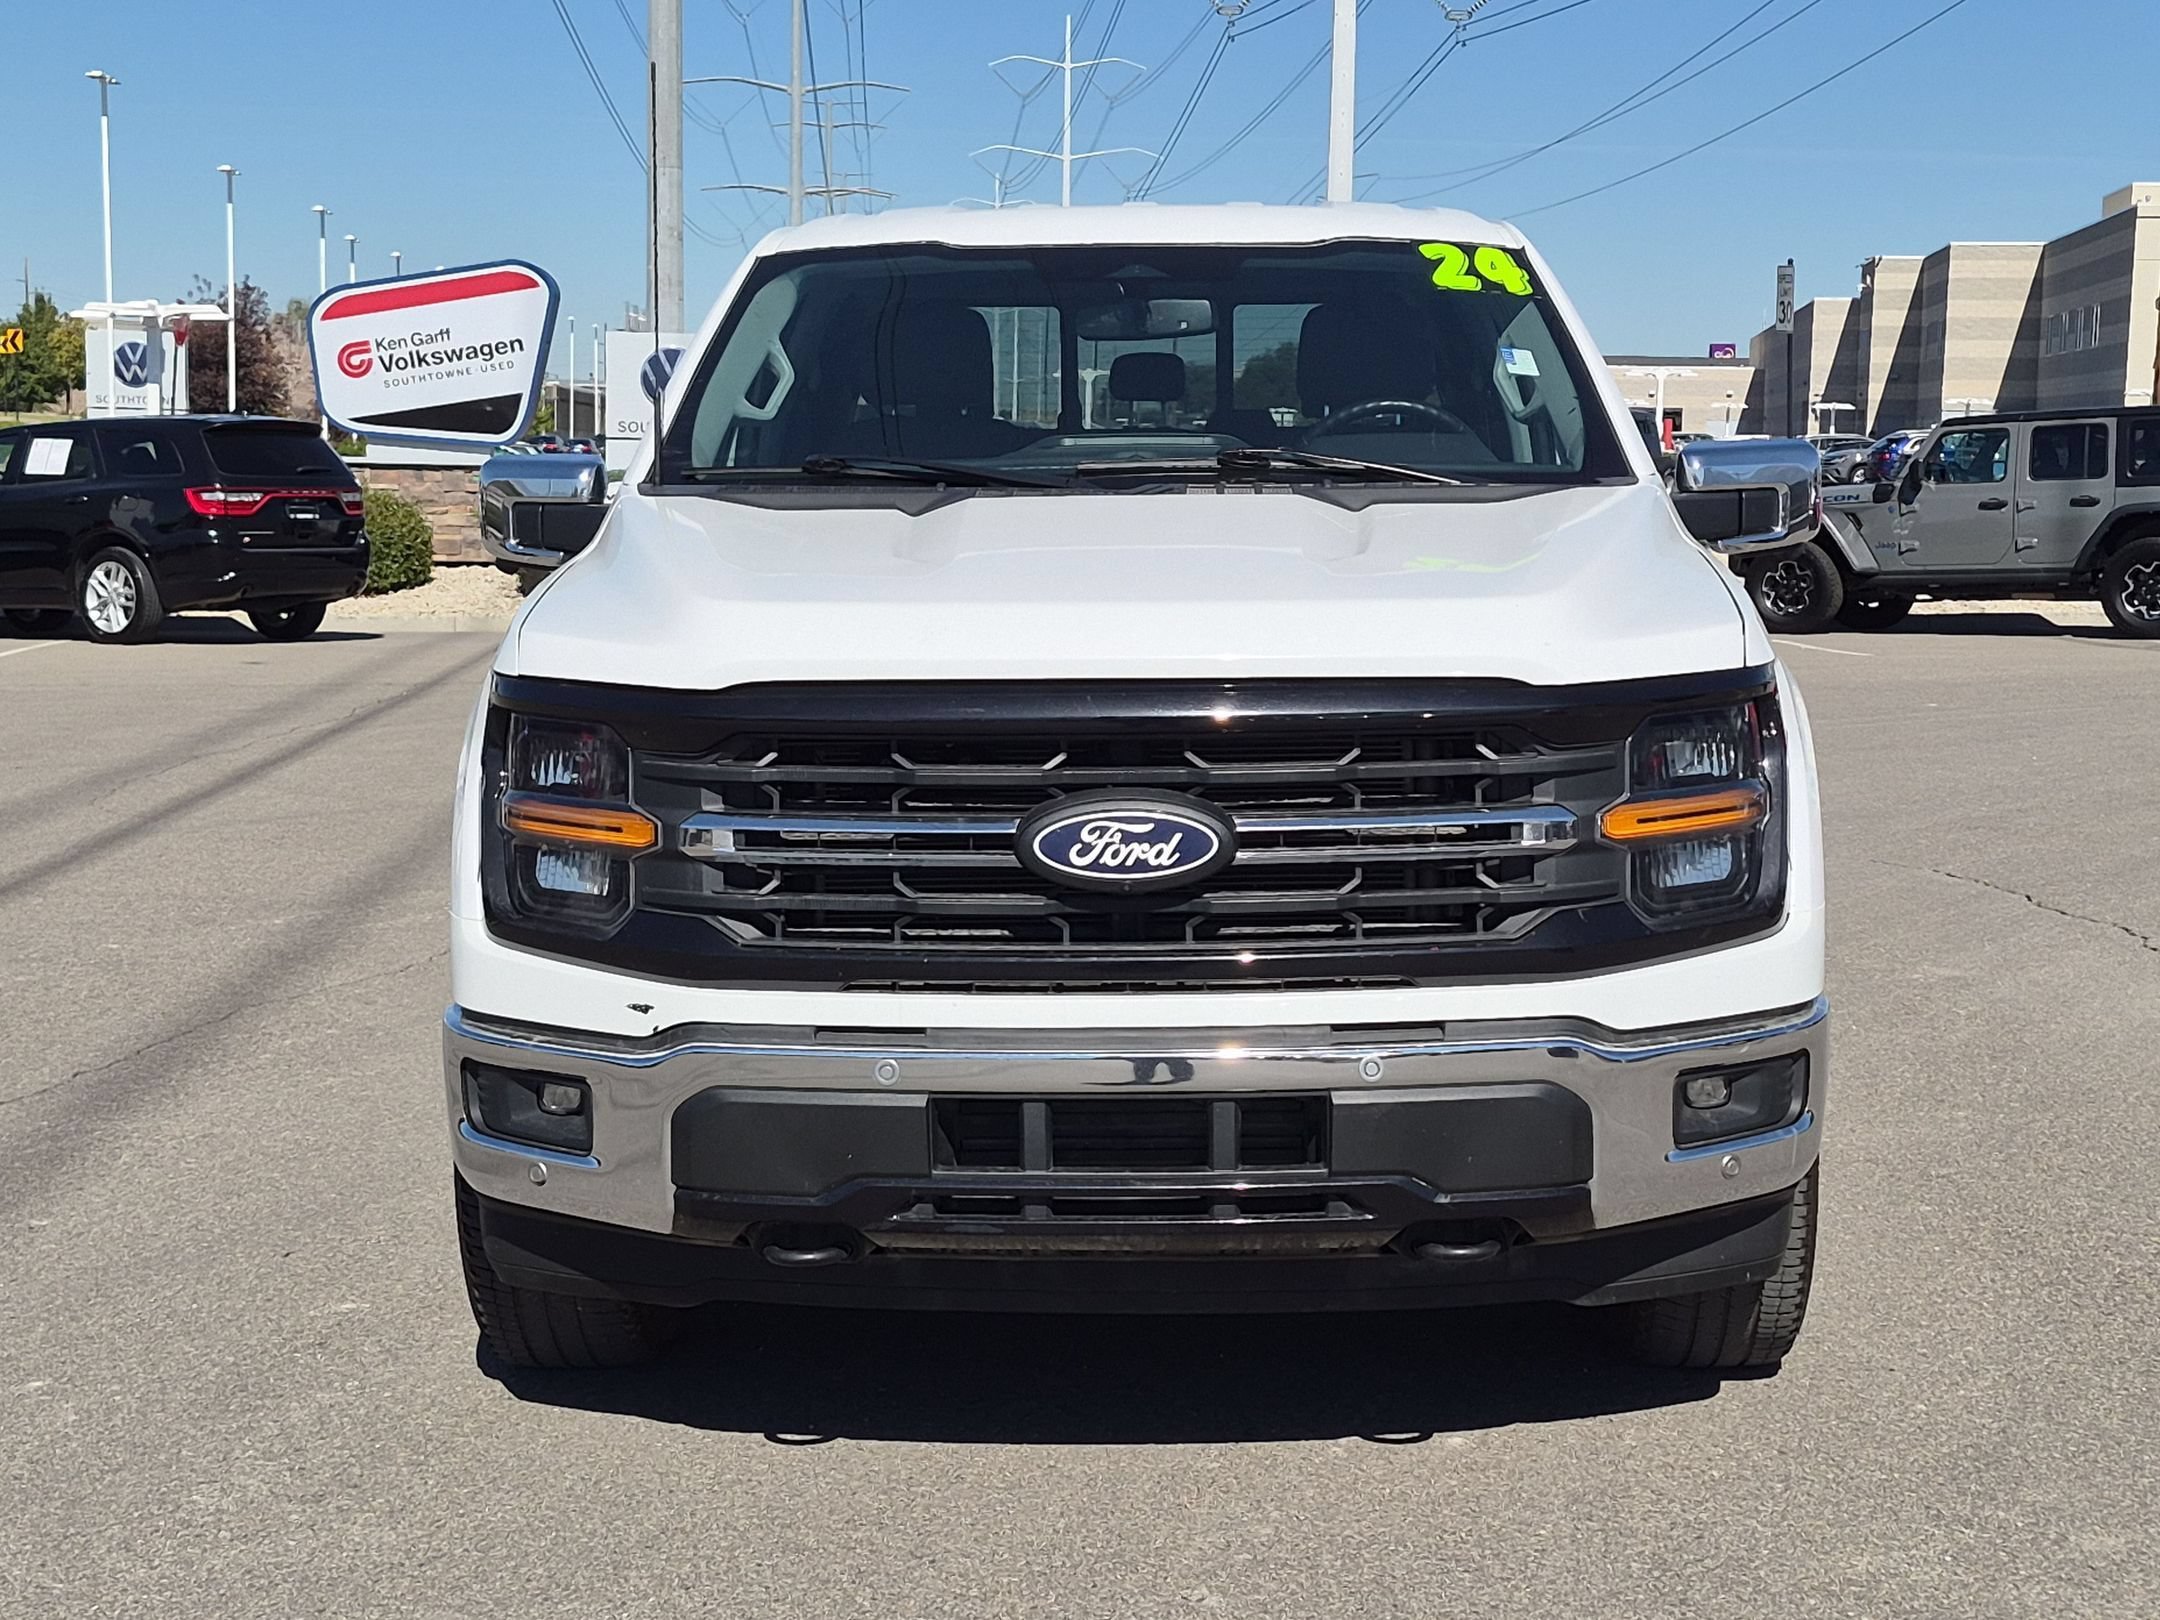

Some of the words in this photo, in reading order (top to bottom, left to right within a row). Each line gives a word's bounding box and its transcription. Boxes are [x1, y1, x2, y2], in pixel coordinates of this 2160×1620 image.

[1418, 243, 1533, 296] 24
[1778, 300, 1792, 324] 30
[375, 337, 408, 352] Ken
[410, 328, 450, 347] Garff
[378, 338, 524, 373] Volkswagen
[383, 366, 473, 388] SOUTHTOWNE
[480, 360, 515, 373] USED
[1069, 820, 1183, 867] Ford
